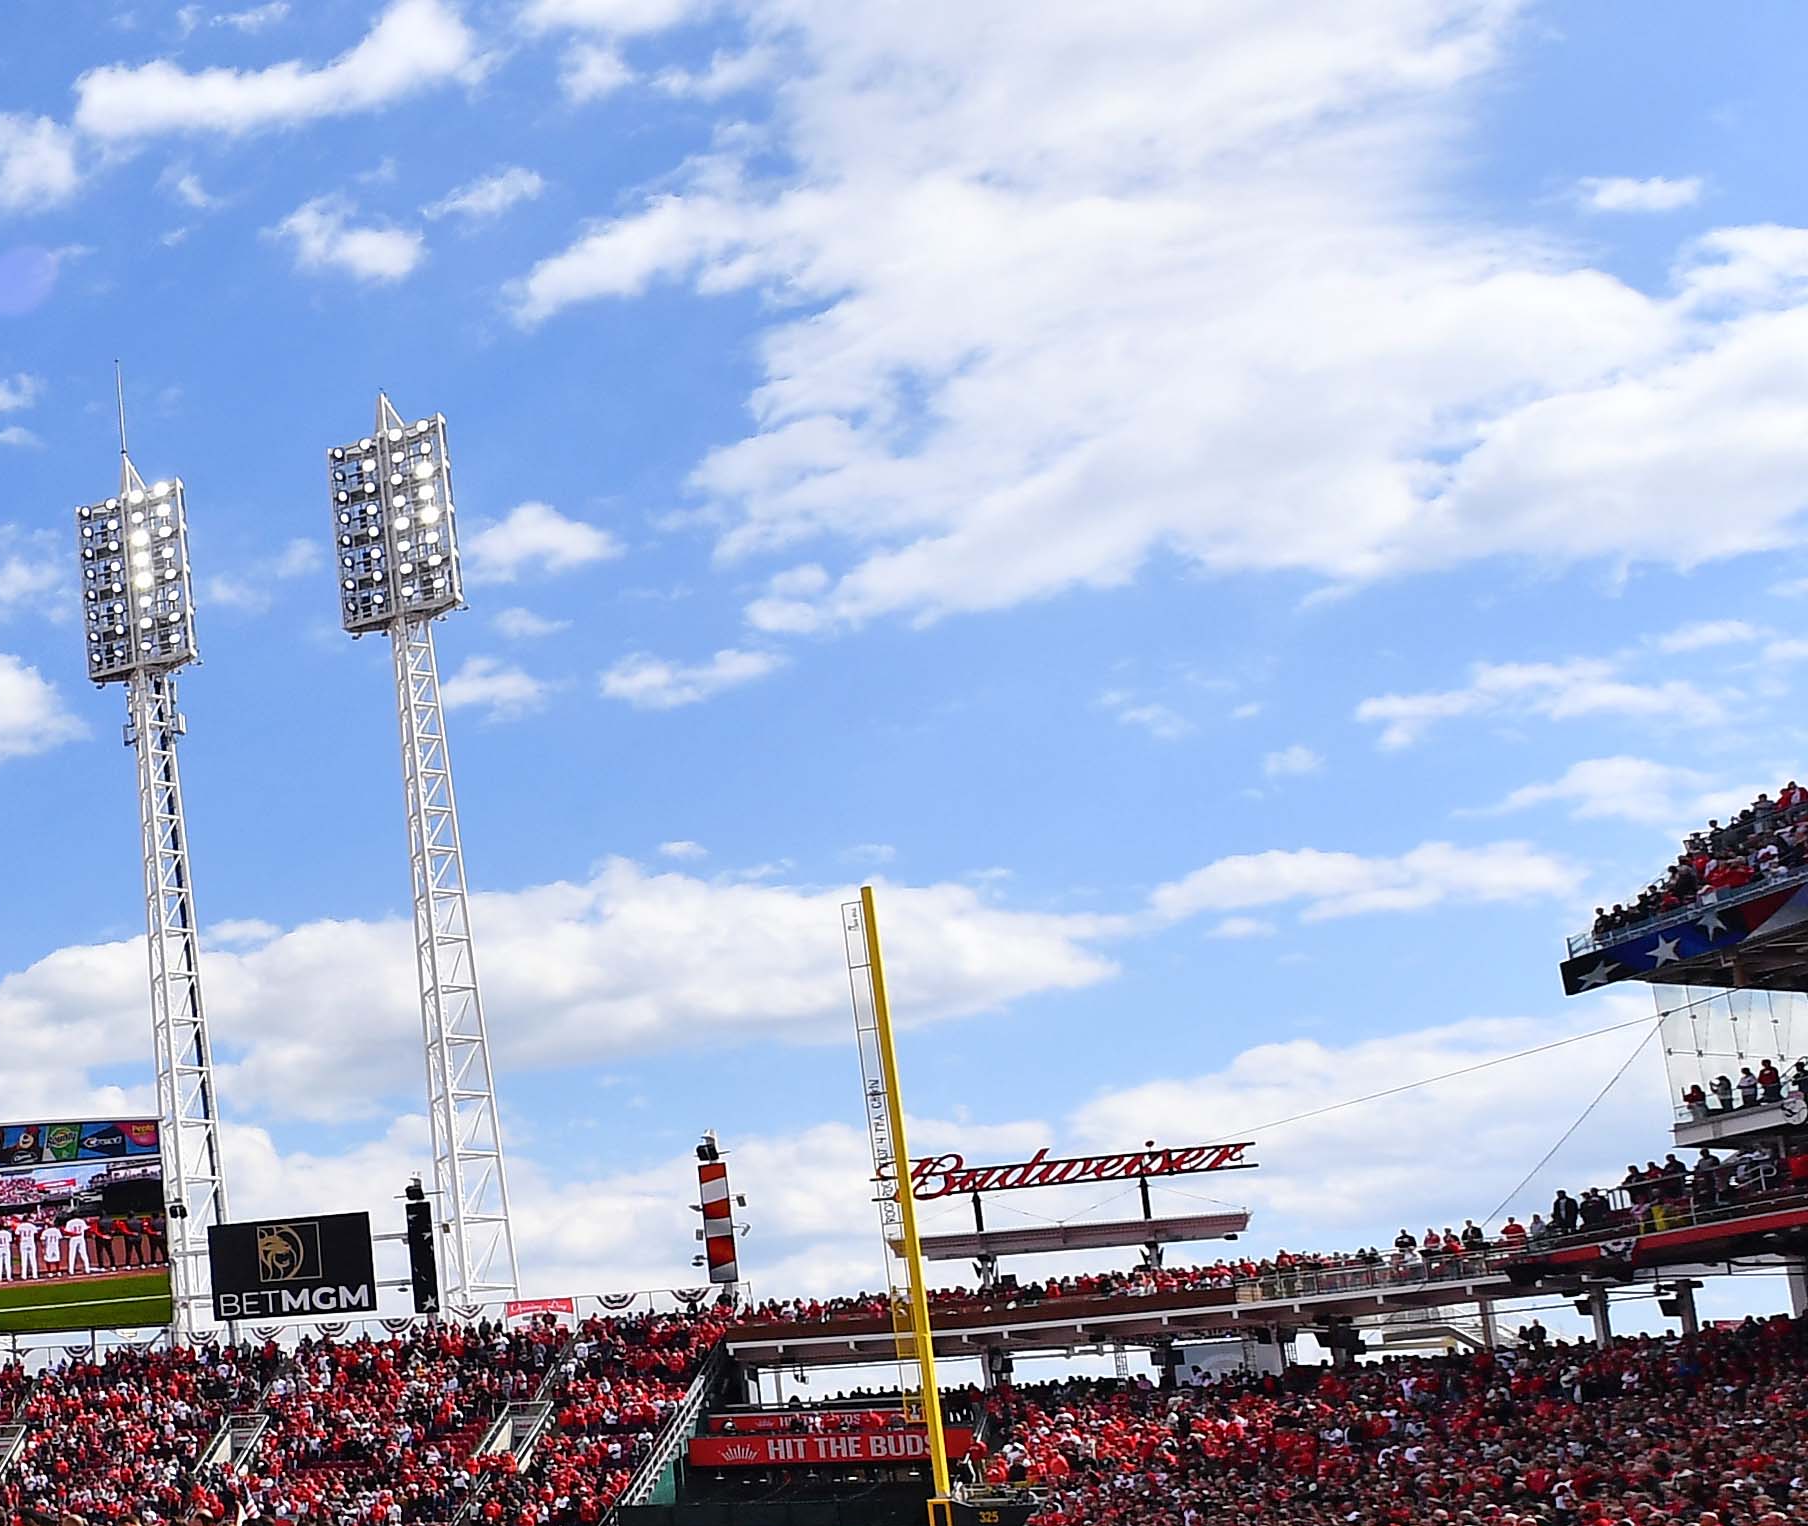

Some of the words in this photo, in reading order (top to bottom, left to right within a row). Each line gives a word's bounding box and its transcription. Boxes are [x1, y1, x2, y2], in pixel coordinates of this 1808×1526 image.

[877, 1141, 1248, 1200] Budweiser
[219, 1284, 370, 1317] BETMGM
[766, 1437, 807, 1461] HIT
[814, 1436, 864, 1459] THE
[979, 1511, 999, 1523] 325
